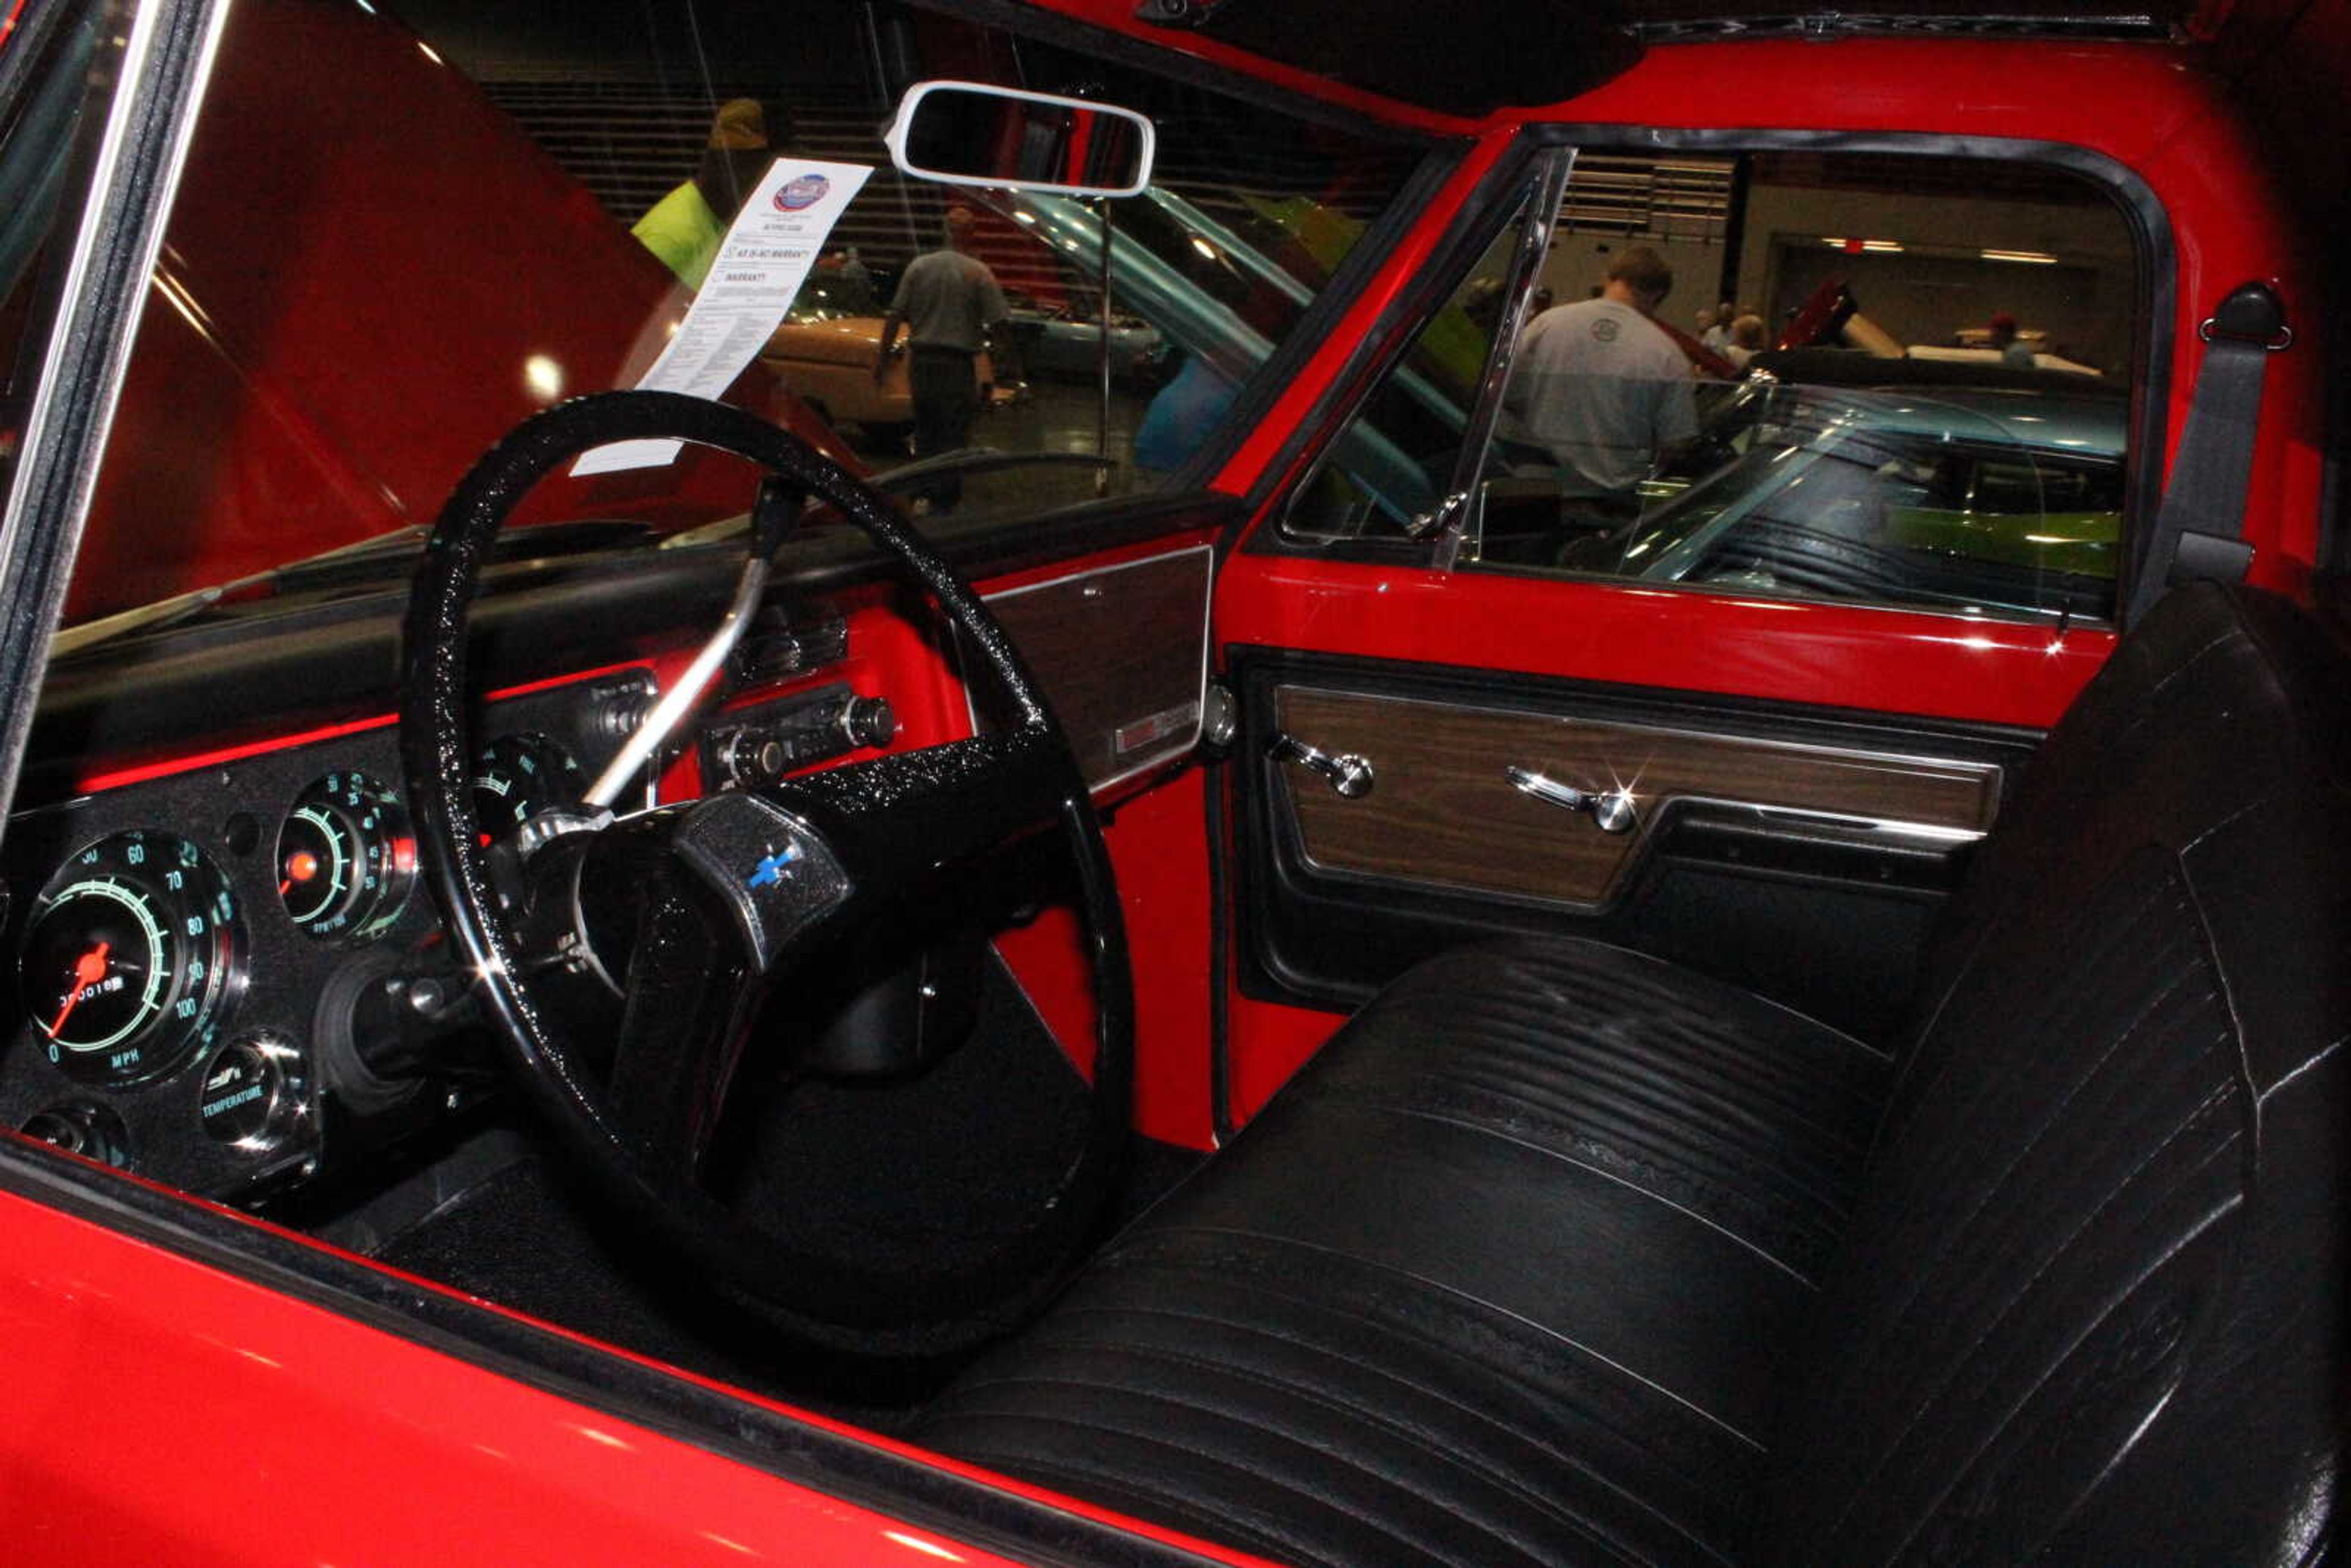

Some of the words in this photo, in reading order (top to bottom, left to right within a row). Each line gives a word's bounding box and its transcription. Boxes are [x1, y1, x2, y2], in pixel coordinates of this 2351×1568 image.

[726, 272, 766, 282] WARRANTY
[127, 844, 144, 865] 60
[165, 870, 182, 891] 70
[188, 916, 203, 936] 80
[188, 961, 204, 980] 90
[176, 997, 197, 1019] 100
[48, 1043, 60, 1063] 0
[111, 1048, 140, 1069] MPH
[203, 1084, 263, 1118] TEMPERATURE
